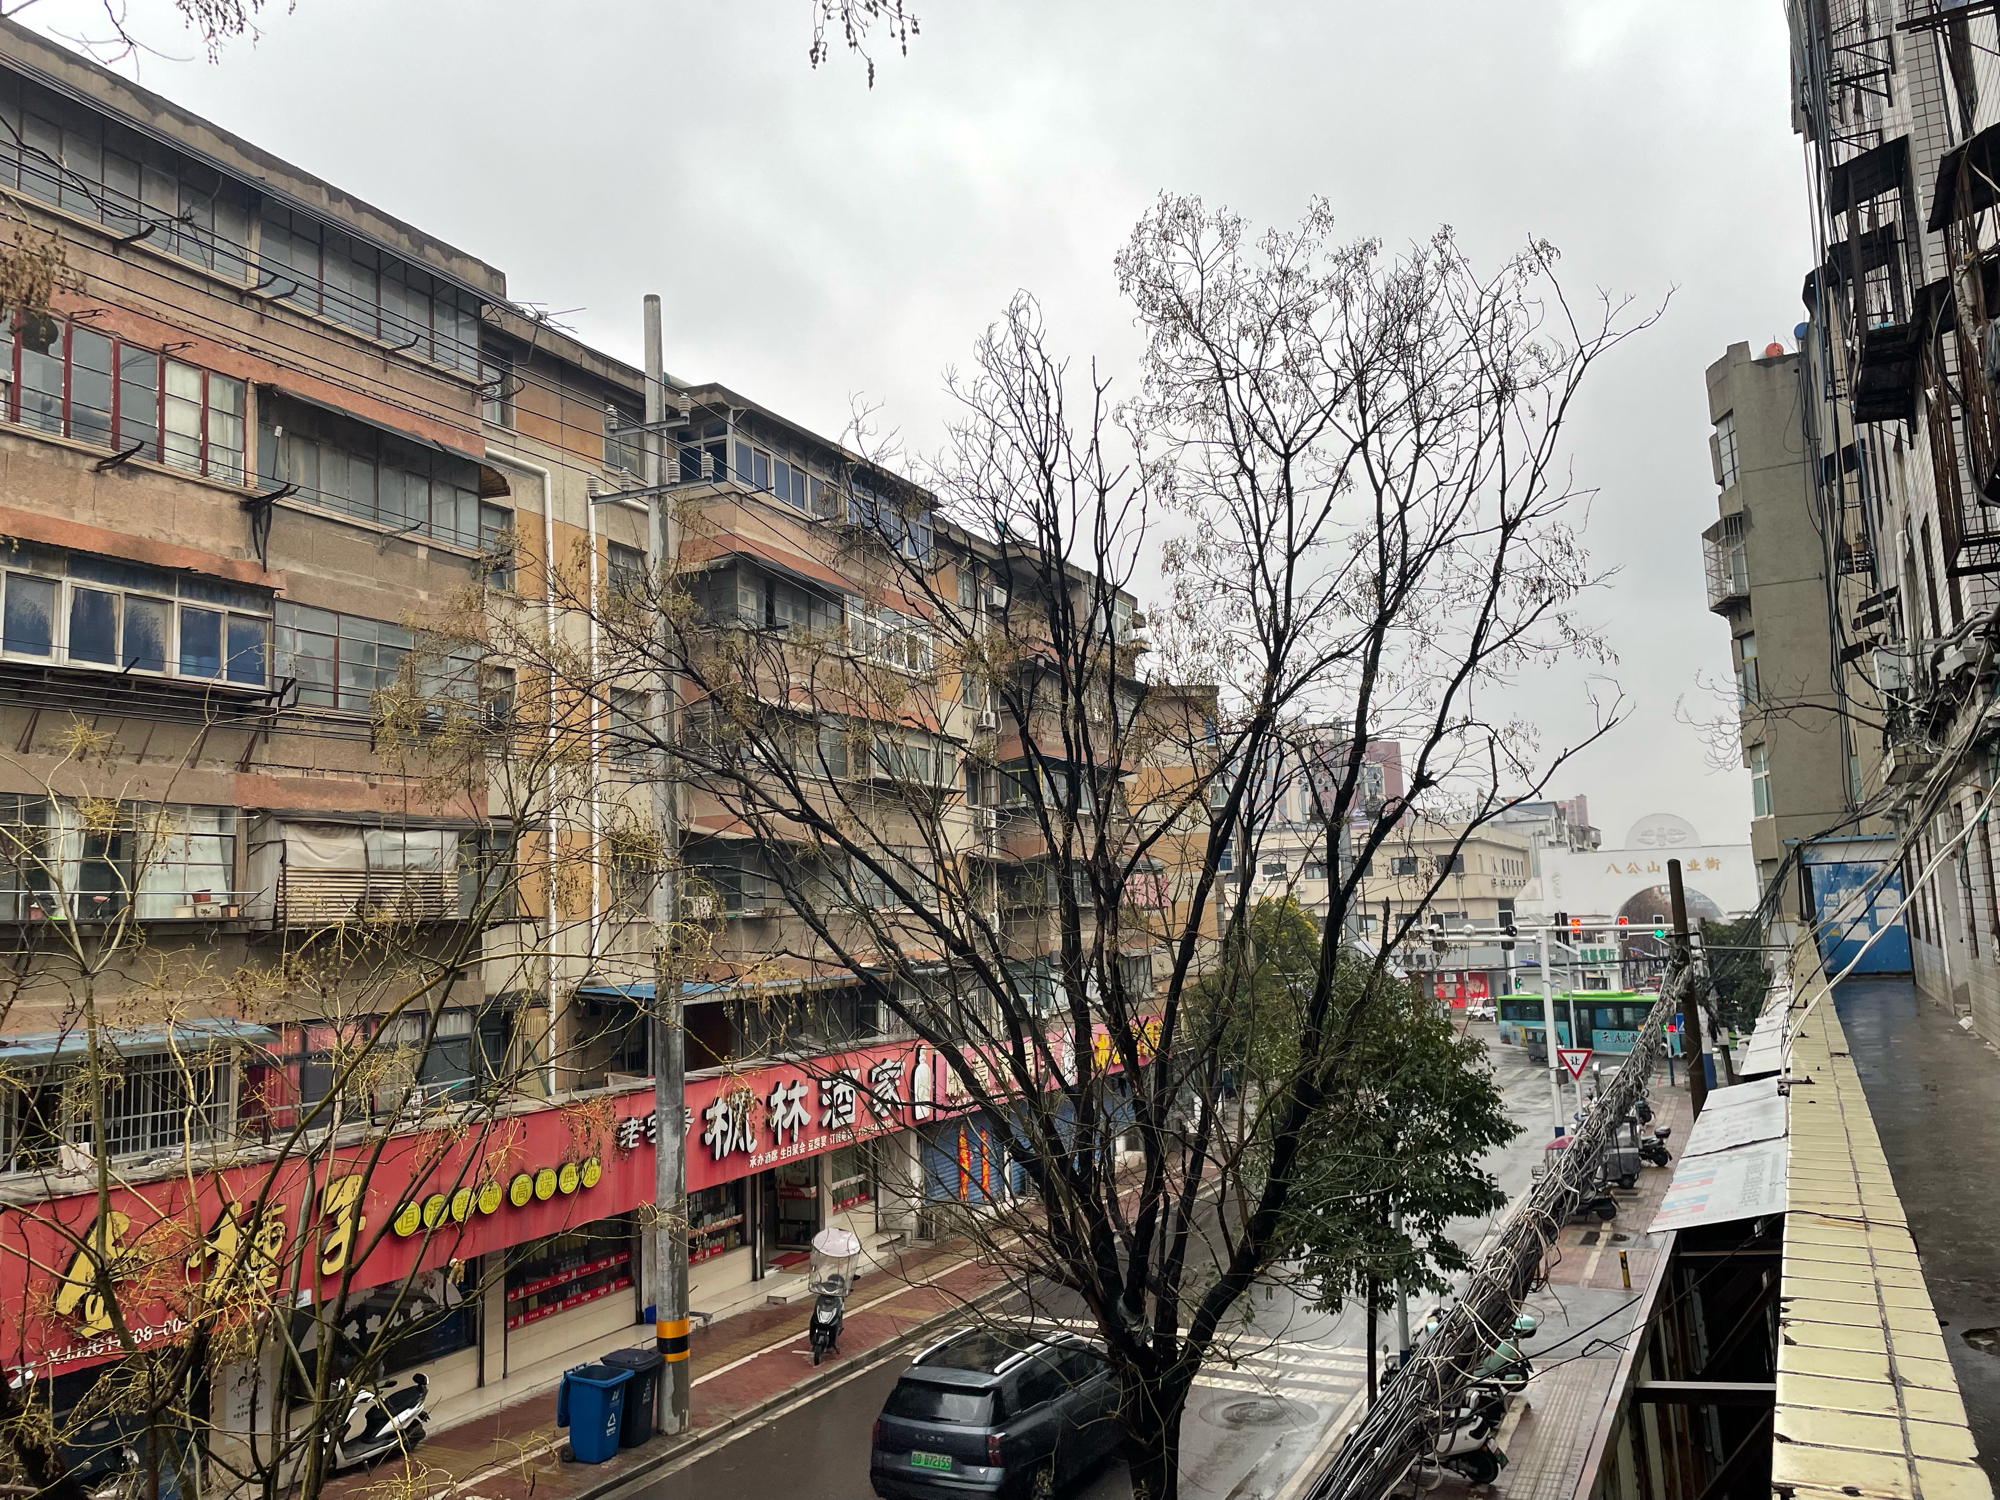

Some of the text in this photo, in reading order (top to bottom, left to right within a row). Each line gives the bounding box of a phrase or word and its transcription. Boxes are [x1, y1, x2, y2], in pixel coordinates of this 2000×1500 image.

[1605, 856, 1721, 875] 八公山业街
[1570, 1055, 1581, 1066] 让
[749, 1148, 779, 1169] 承办酒席
[779, 1141, 807, 1160] 生日聚会
